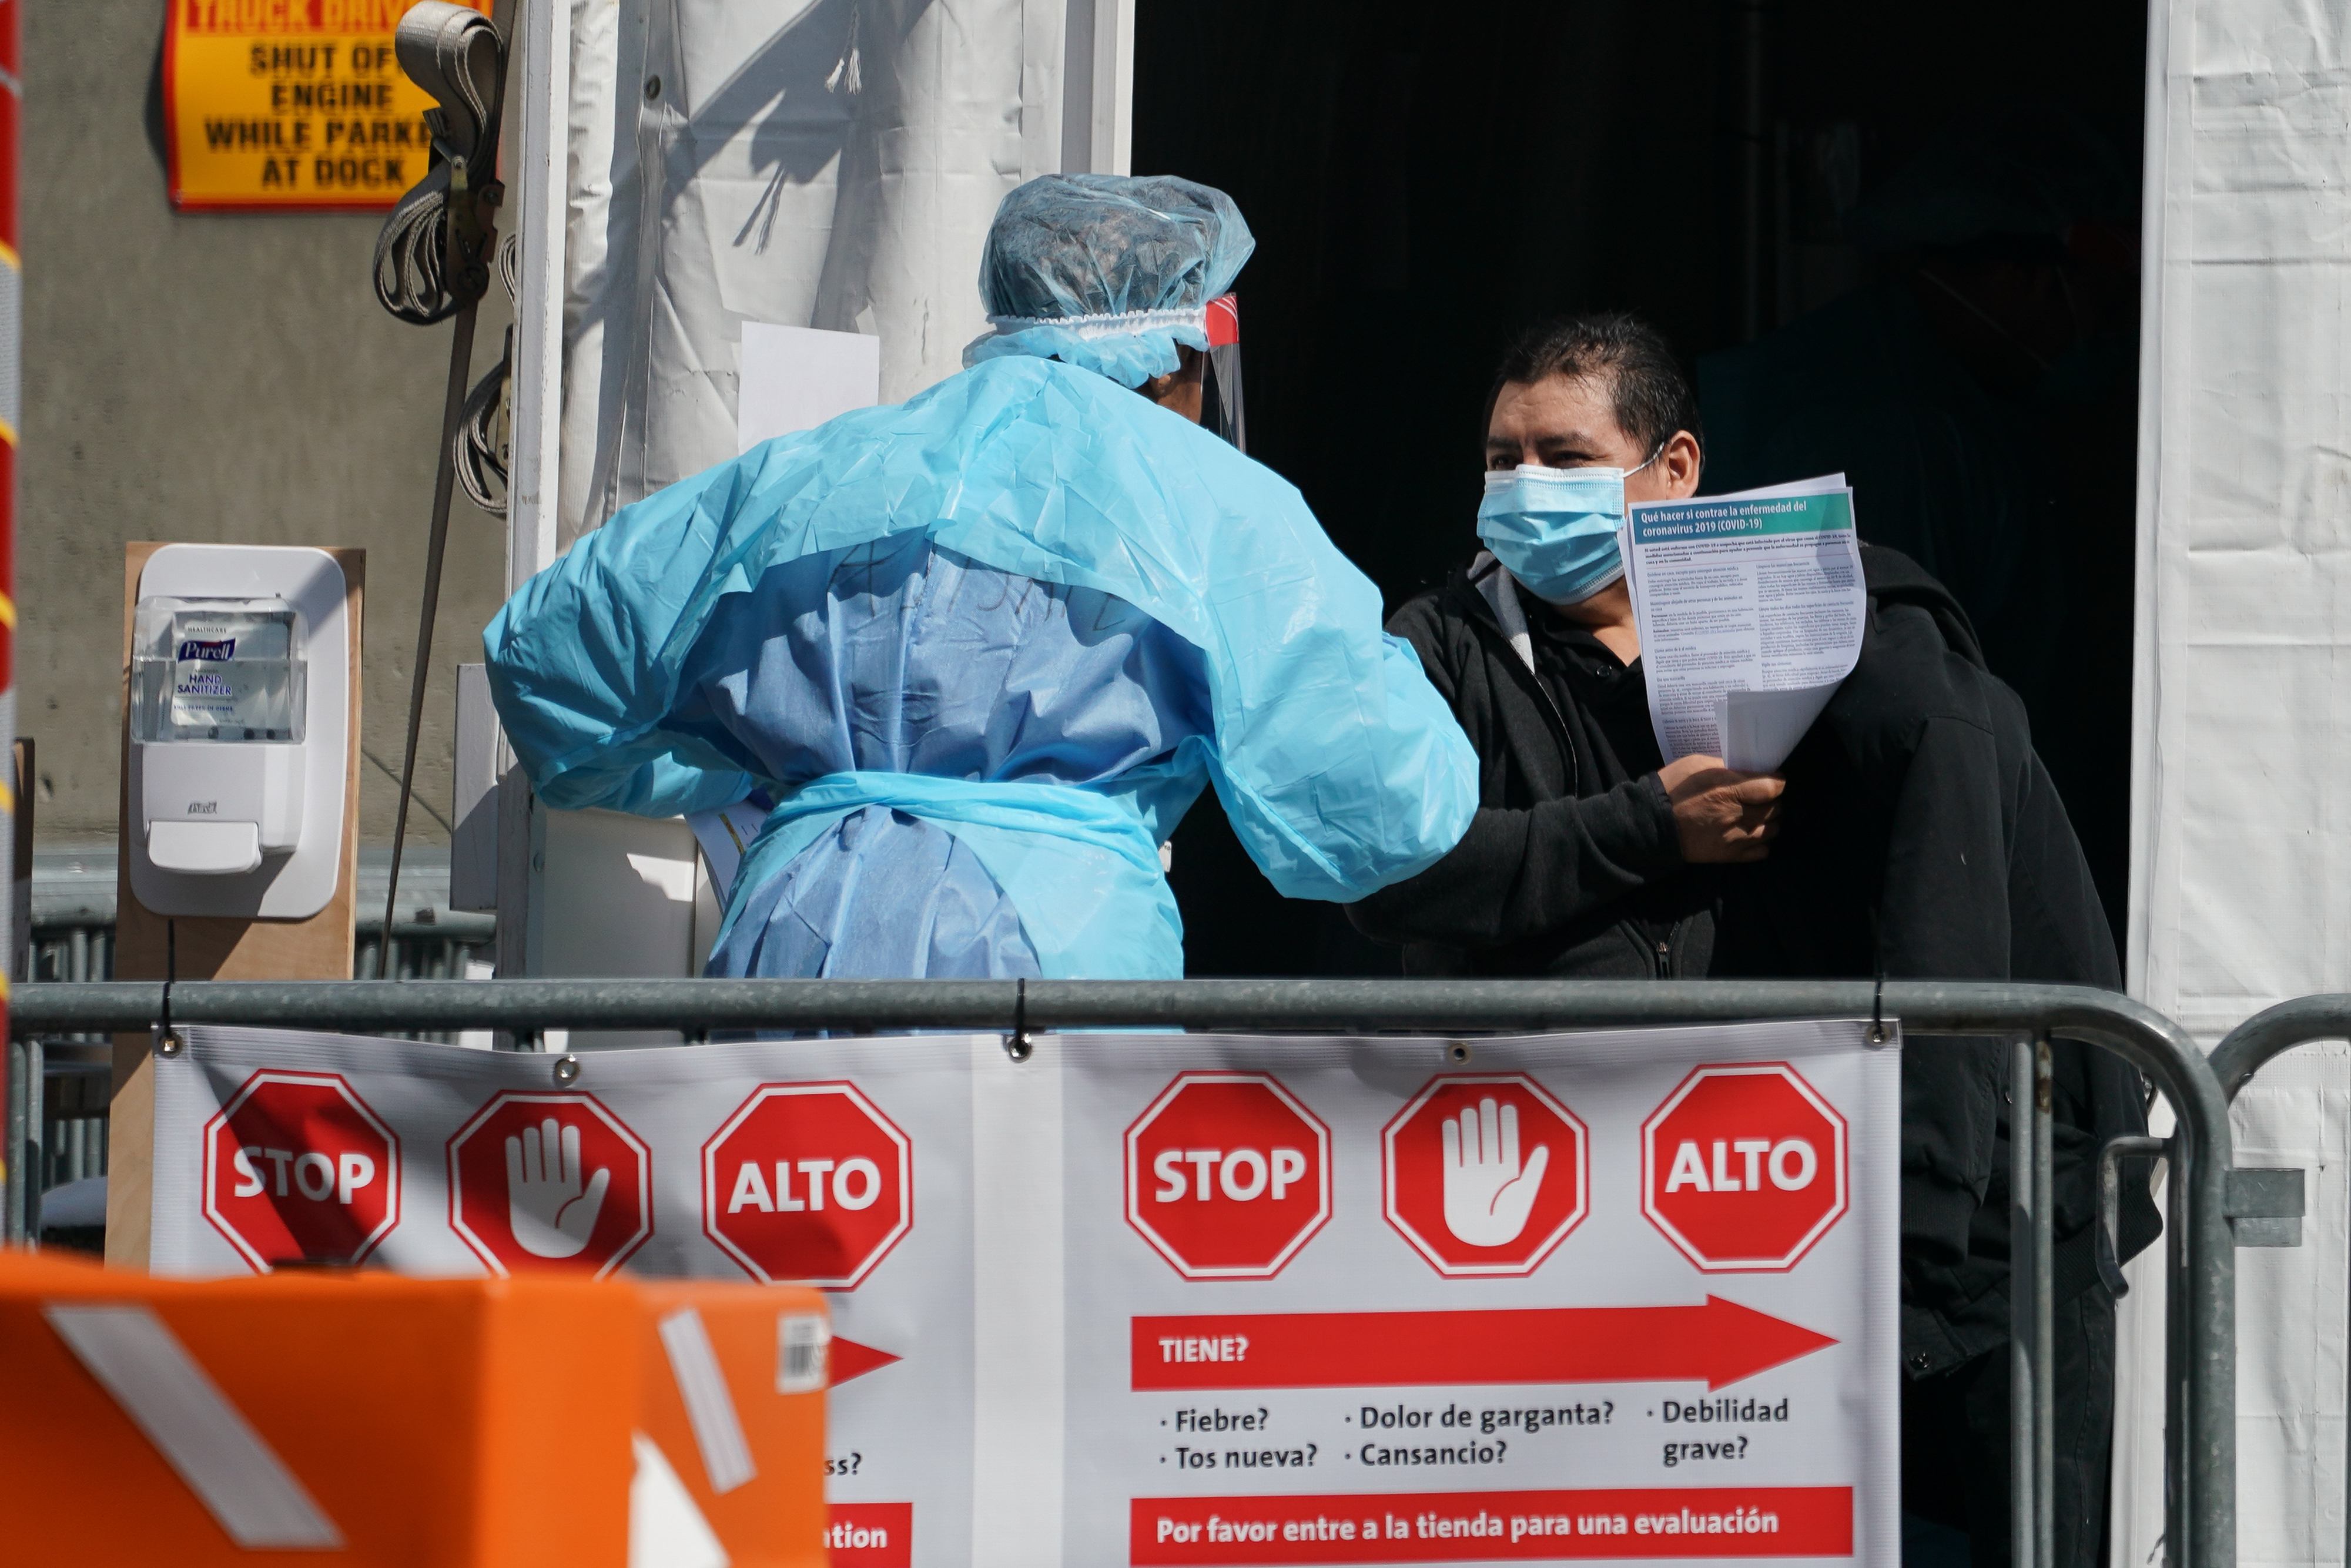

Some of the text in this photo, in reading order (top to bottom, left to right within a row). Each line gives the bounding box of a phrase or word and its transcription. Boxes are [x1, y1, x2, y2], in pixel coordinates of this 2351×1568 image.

[322, 0, 410, 31] DRIV
[251, 45, 401, 73] SHUT OF
[272, 83, 393, 111] ENGINE
[206, 119, 430, 150] WHILE PARKE
[263, 158, 404, 189] AT DOCK
[1641, 500, 1807, 524] Qué hacer si contrae la enfermedad del
[1643, 518, 1763, 537] coronavirus 2019 (COVID-19)
[178, 684, 232, 695] SANITIZER
[189, 674, 222, 684] HAND
[233, 1146, 375, 1204] STOP
[1154, 1149, 1306, 1202] STOP
[1665, 1138, 1817, 1193] ALTO
[728, 1157, 881, 1213] ALTO
[1159, 1336, 1248, 1362] TIENE?
[1176, 1408, 1268, 1432] Fiebre?
[1361, 1401, 1614, 1435] Dolor de garganta?
[1663, 1398, 1788, 1423] Debilidad
[1176, 1443, 1317, 1469] Tos nueva?
[1360, 1440, 1507, 1467] Cansancio?
[1663, 1436, 1748, 1468] grave?
[1157, 1507, 1779, 1543] Por favor entre a la tienda para una evaluación
